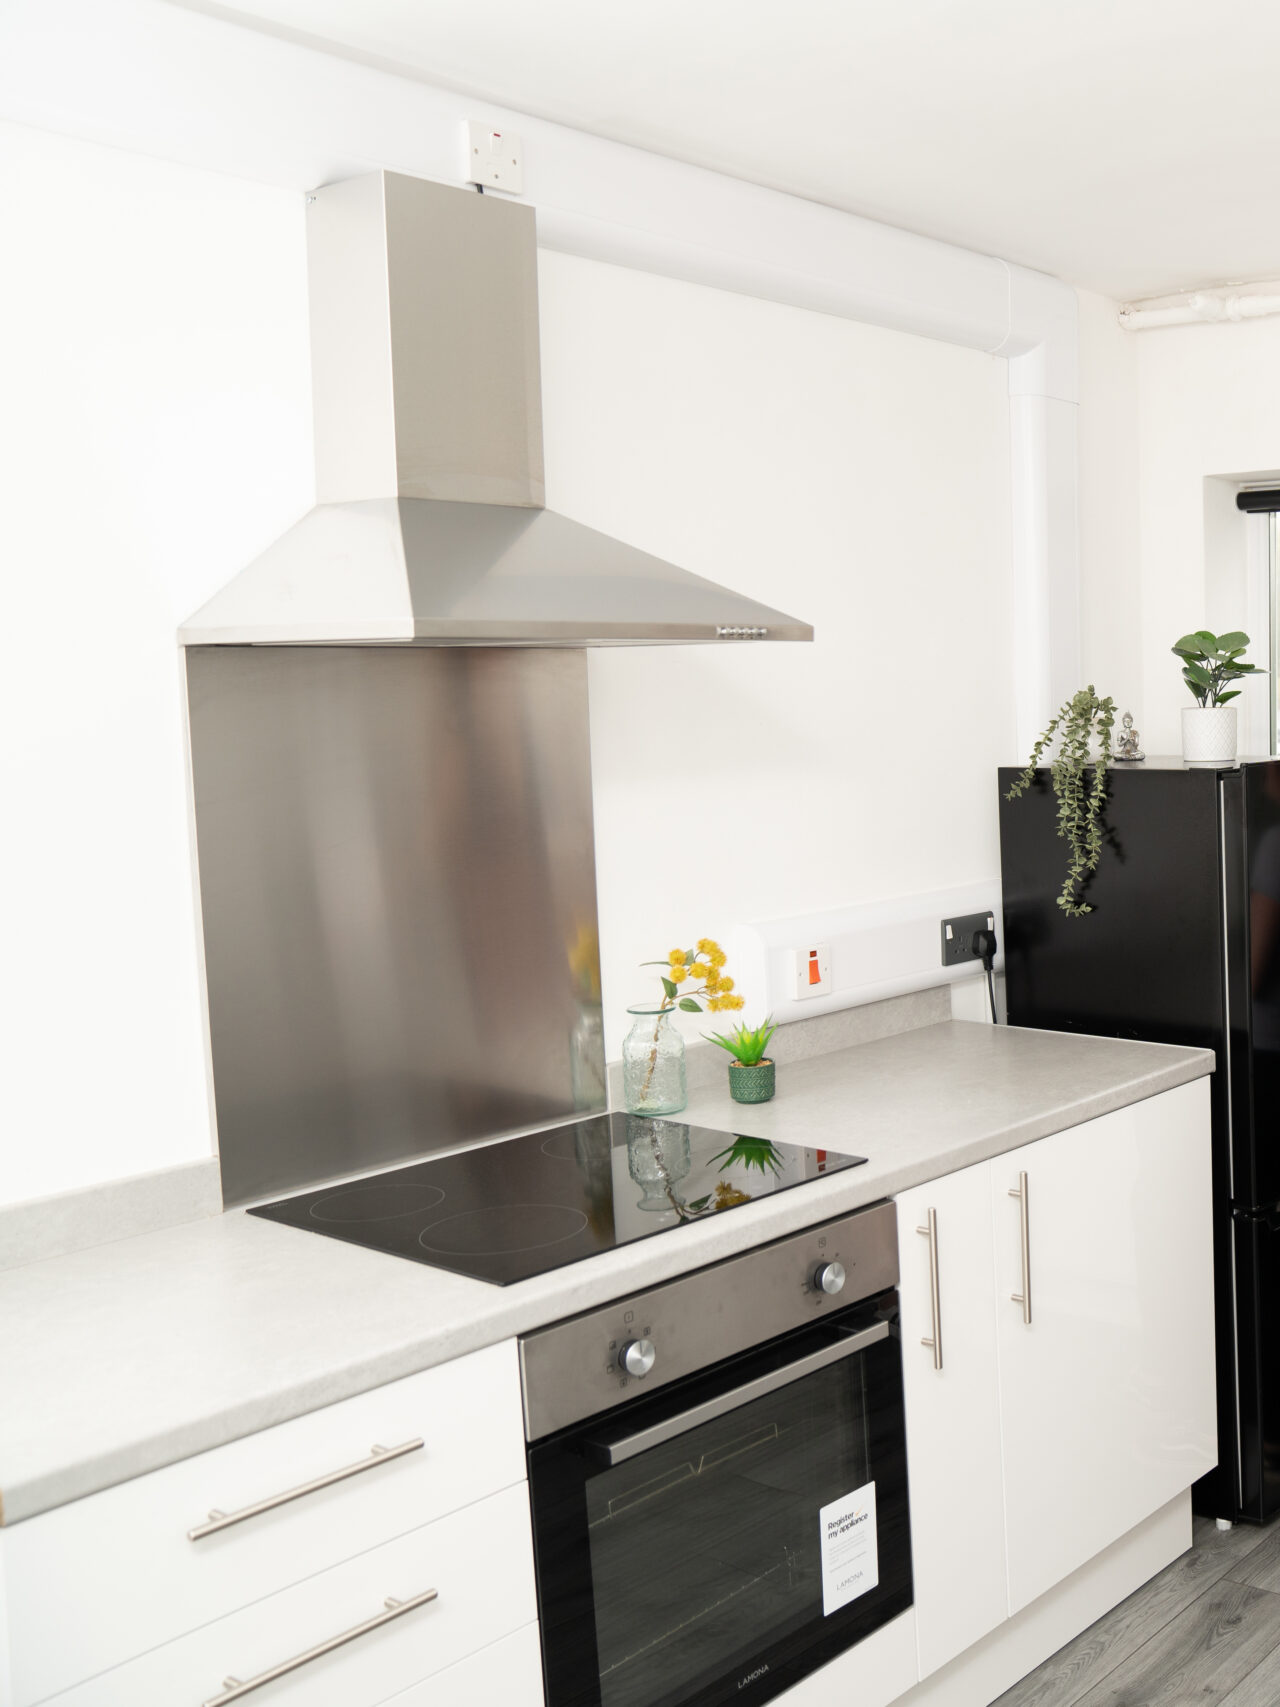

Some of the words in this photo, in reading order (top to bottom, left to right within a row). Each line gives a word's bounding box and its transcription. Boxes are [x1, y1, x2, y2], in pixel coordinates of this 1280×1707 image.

[828, 1511, 854, 1530] Register
[828, 1529, 838, 1540] my
[840, 1513, 868, 1534] appliance
[836, 1570, 863, 1590] LAMONA
[738, 1664, 769, 1689] LAMONA
